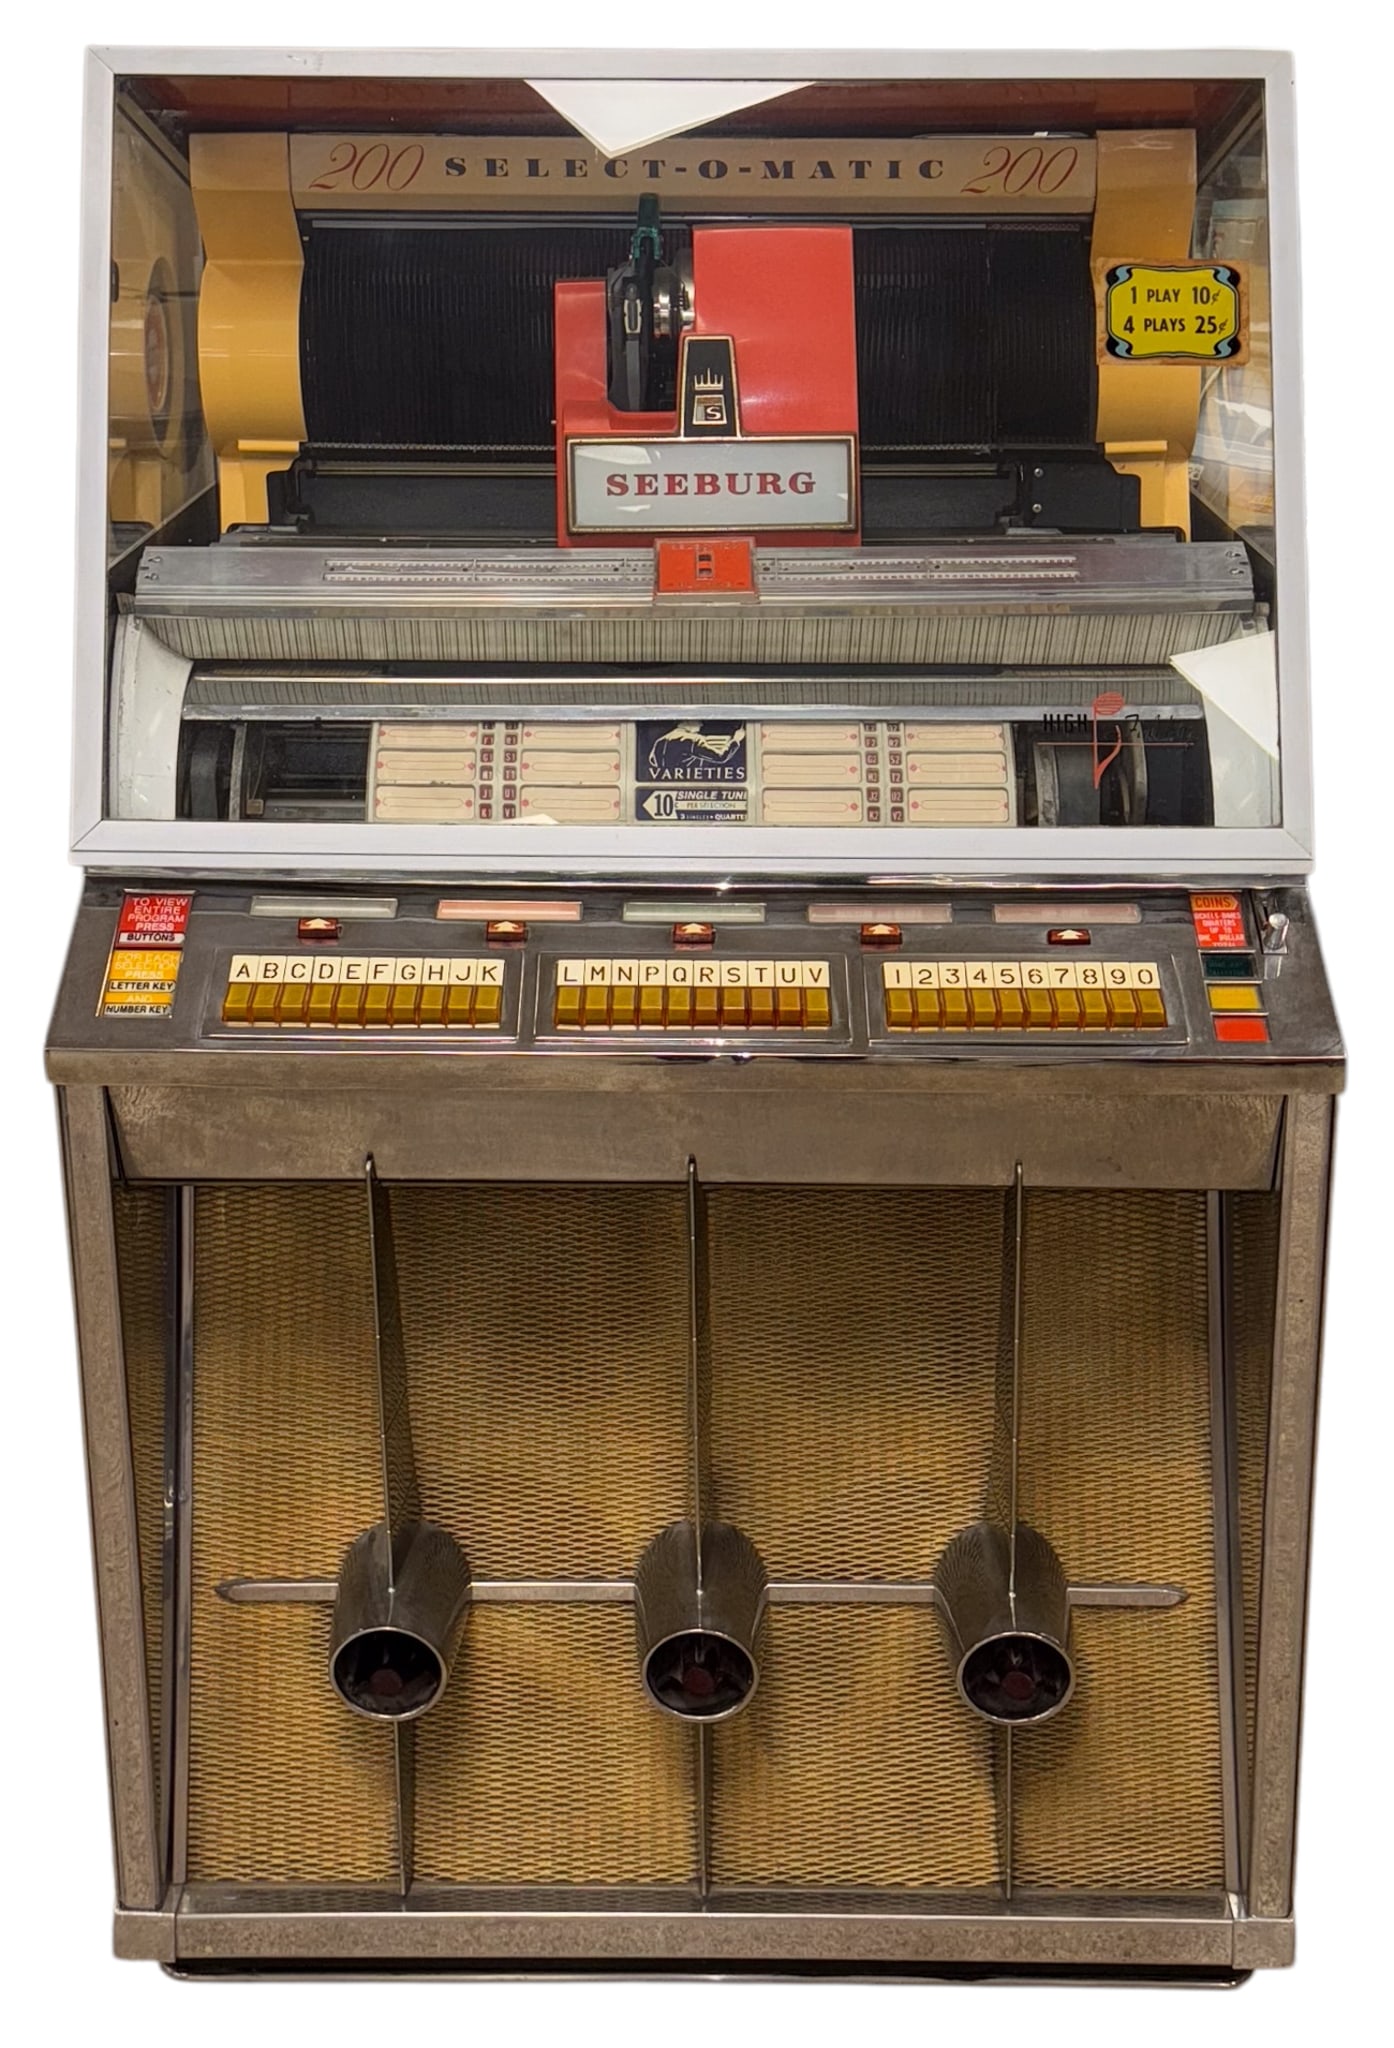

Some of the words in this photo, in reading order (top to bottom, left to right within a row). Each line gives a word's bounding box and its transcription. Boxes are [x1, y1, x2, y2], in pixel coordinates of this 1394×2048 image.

[309, 143, 425, 191] 200
[444, 157, 944, 181] SELECT-O-MATIC
[960, 146, 1079, 194] 200
[1130, 286, 1137, 305] 1
[1147, 289, 1180, 302] PLAY
[1123, 315, 1135, 333] 4
[1144, 318, 1186, 332] PLAYS
[705, 406, 722, 420] S
[607, 472, 816, 496] SEEBURG
[1043, 713, 1088, 732] HIGH
[649, 767, 745, 779] VARIETIES
[677, 791, 718, 800] SINGLE
[654, 794, 674, 816] 10
[132, 898, 150, 906] TO
[155, 898, 188, 906] VIEW
[1195, 897, 1232, 908] COINS
[134, 906, 181, 914] ENTIRE
[127, 914, 185, 922] PROGRAM
[135, 922, 175, 931] PRESS
[127, 933, 175, 941] BUTTONS
[235, 963, 251, 978] A
[263, 963, 279, 979] B
[291, 963, 306, 979] C
[318, 964, 334, 979] D
[346, 964, 362, 980] E
[373, 964, 389, 980] F
[401, 965, 416, 980] G
[428, 965, 443, 981] H
[455, 965, 471, 981] J
[482, 966, 498, 981] K
[564, 966, 577, 982] L
[590, 967, 605, 982] M
[618, 967, 632, 982] N
[645, 967, 659, 982] P
[672, 967, 687, 983] Q
[700, 967, 714, 983] R
[727, 967, 741, 983] S
[754, 968, 768, 983] T
[782, 968, 796, 983] U
[809, 968, 823, 984] V
[918, 969, 933, 984] 2
[945, 969, 960, 984] 3
[973, 969, 987, 984] 4
[1000, 969, 1015, 984] 5
[1028, 969, 1043, 984] 6
[1054, 969, 1069, 984] 7
[1082, 969, 1098, 984] 8
[1110, 969, 1126, 984] 9
[1138, 969, 1154, 984] 0
[152, 982, 174, 990] KEY
[106, 1005, 146, 1013] NUMBER
